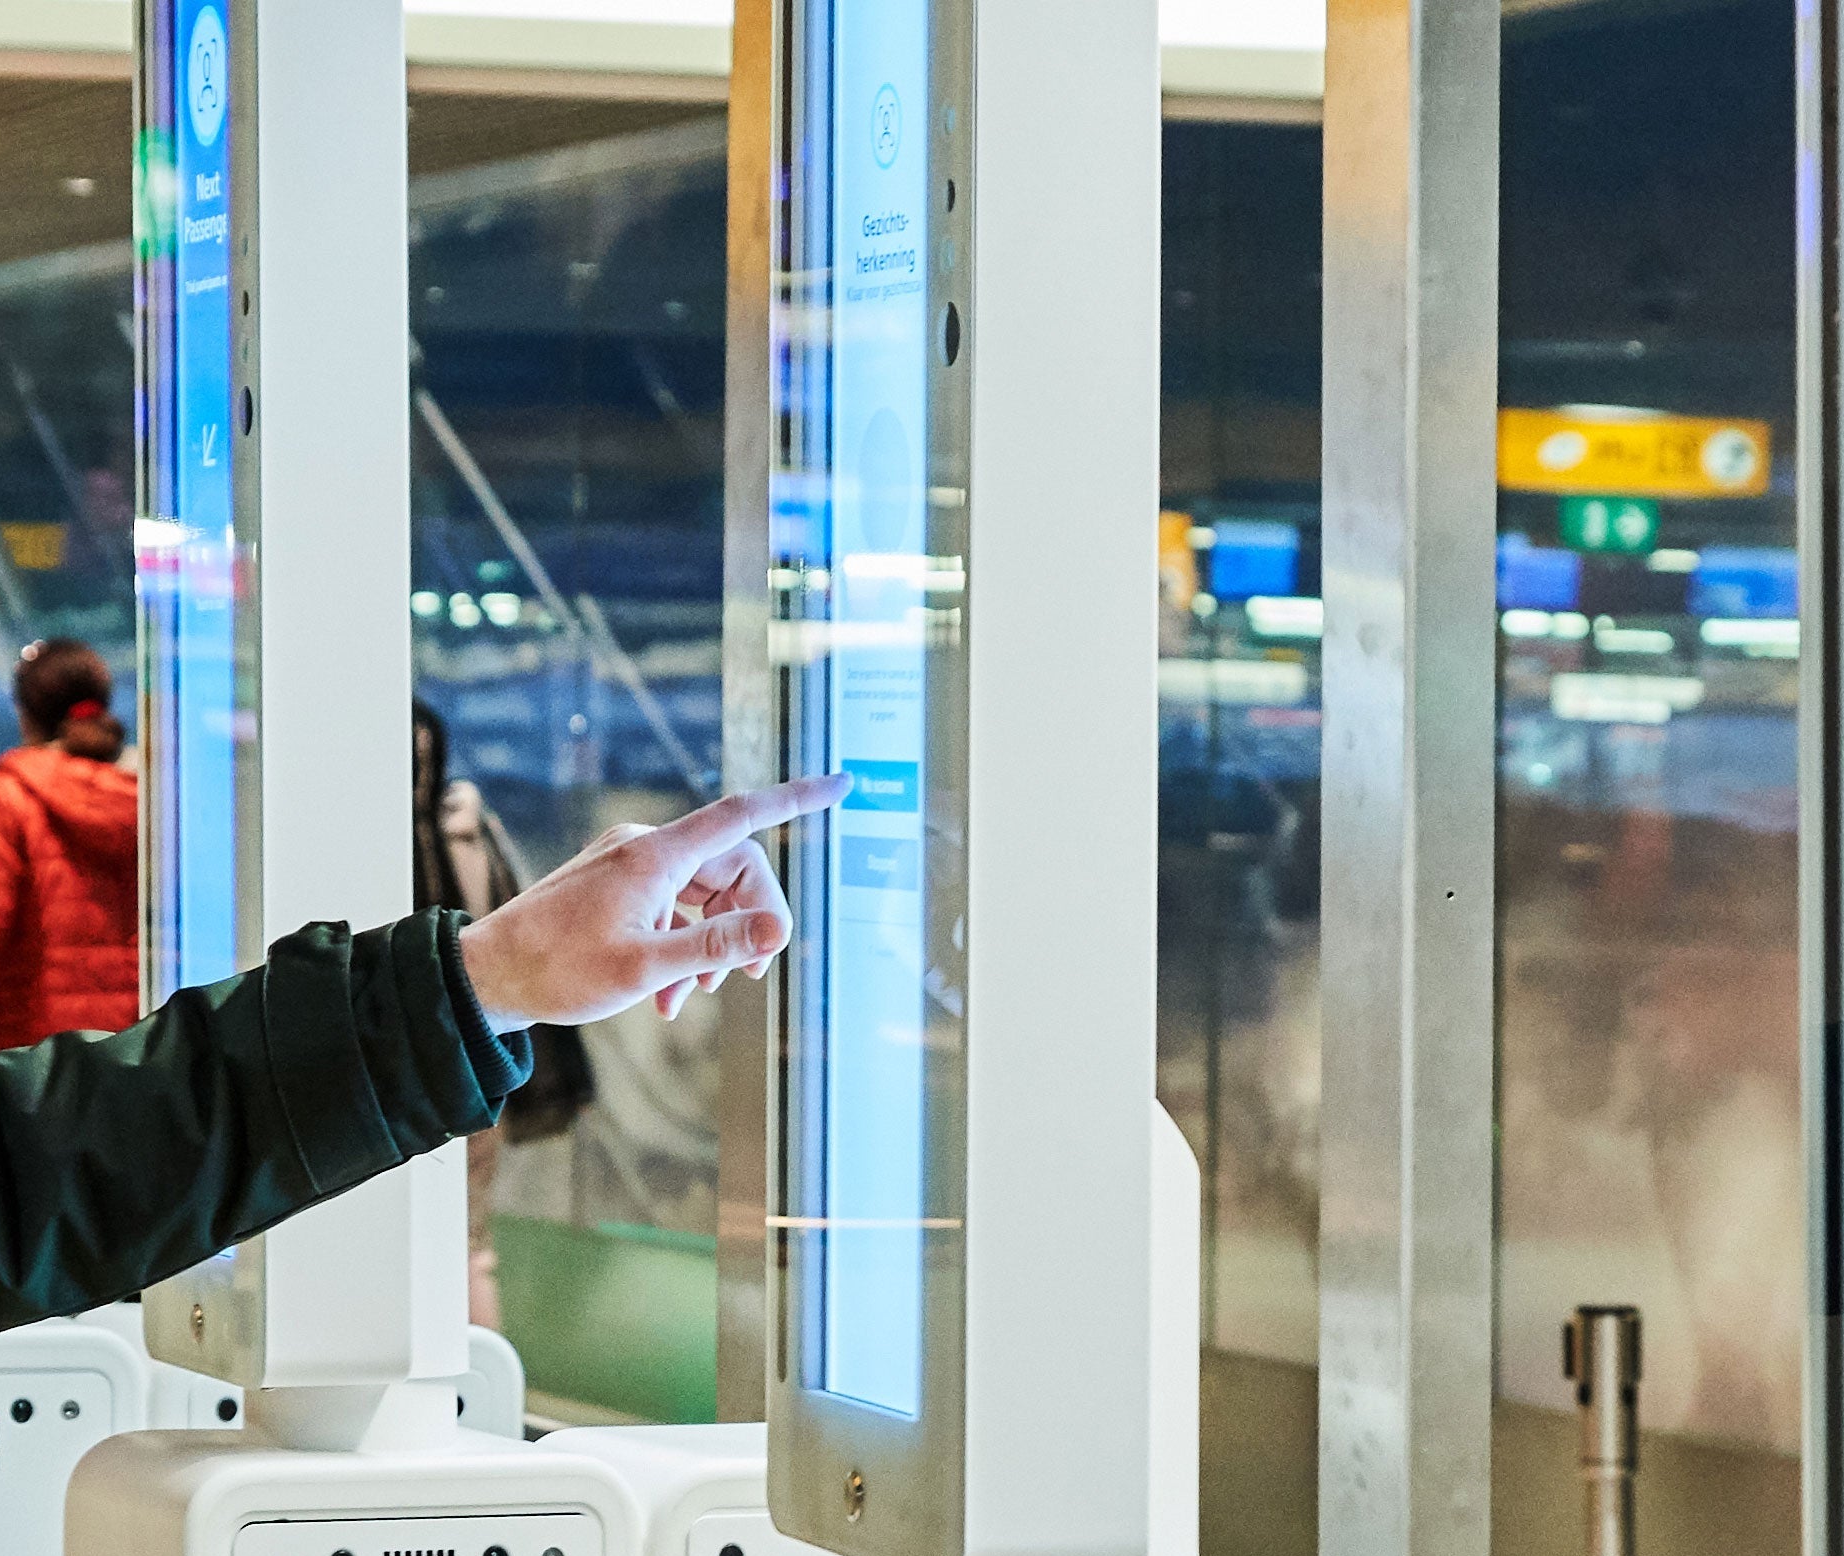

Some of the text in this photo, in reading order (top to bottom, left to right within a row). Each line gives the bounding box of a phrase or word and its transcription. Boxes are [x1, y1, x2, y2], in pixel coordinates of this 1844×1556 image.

[196, 171, 221, 202] Next
[862, 209, 910, 238] Gezichts-
[856, 245, 915, 275] herkenning
